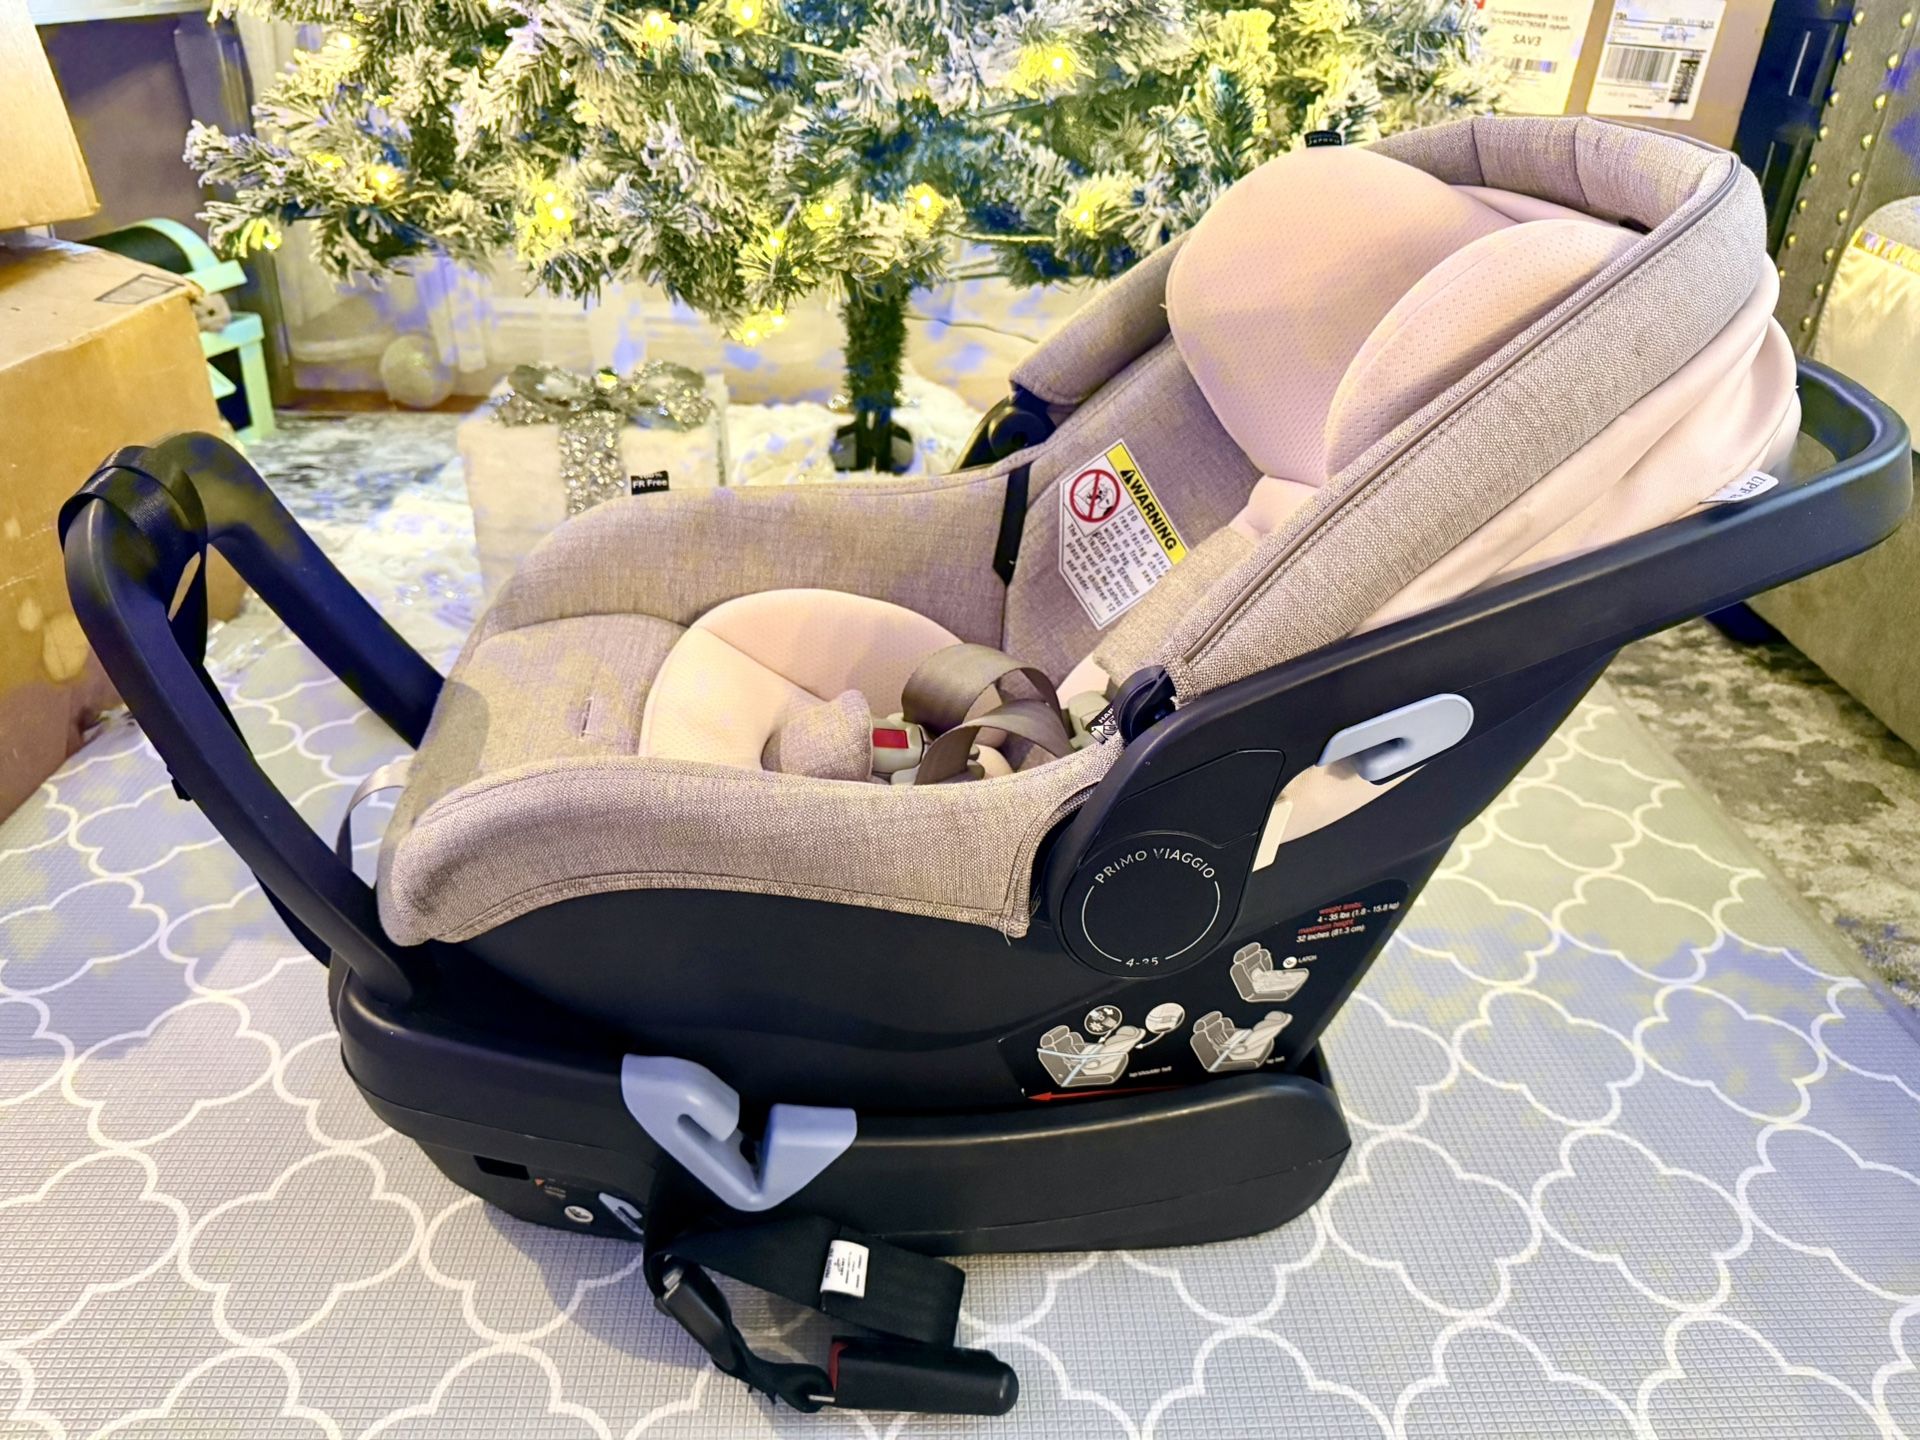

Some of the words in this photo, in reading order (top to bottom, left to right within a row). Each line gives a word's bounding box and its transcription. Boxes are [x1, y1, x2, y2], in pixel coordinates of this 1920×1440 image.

[1126, 509, 1138, 521] DO
[1138, 528, 1152, 544] NOT
[1127, 479, 1179, 550] WARNING
[1067, 524, 1077, 536] The
[1110, 521, 1123, 536] seat
[1117, 514, 1148, 557] rear-facing
[1086, 537, 1106, 563] INJURY
[1094, 531, 1112, 554] DEATH
[1109, 554, 1120, 566] OR
[1117, 566, 1138, 595] SERIOUS
[1106, 603, 1114, 612] 12
[1095, 850, 1147, 884] PRIMO
[1153, 848, 1215, 879] VIAGGIO
[1329, 913, 1338, 921] 35
[1296, 935, 1306, 943] 32
